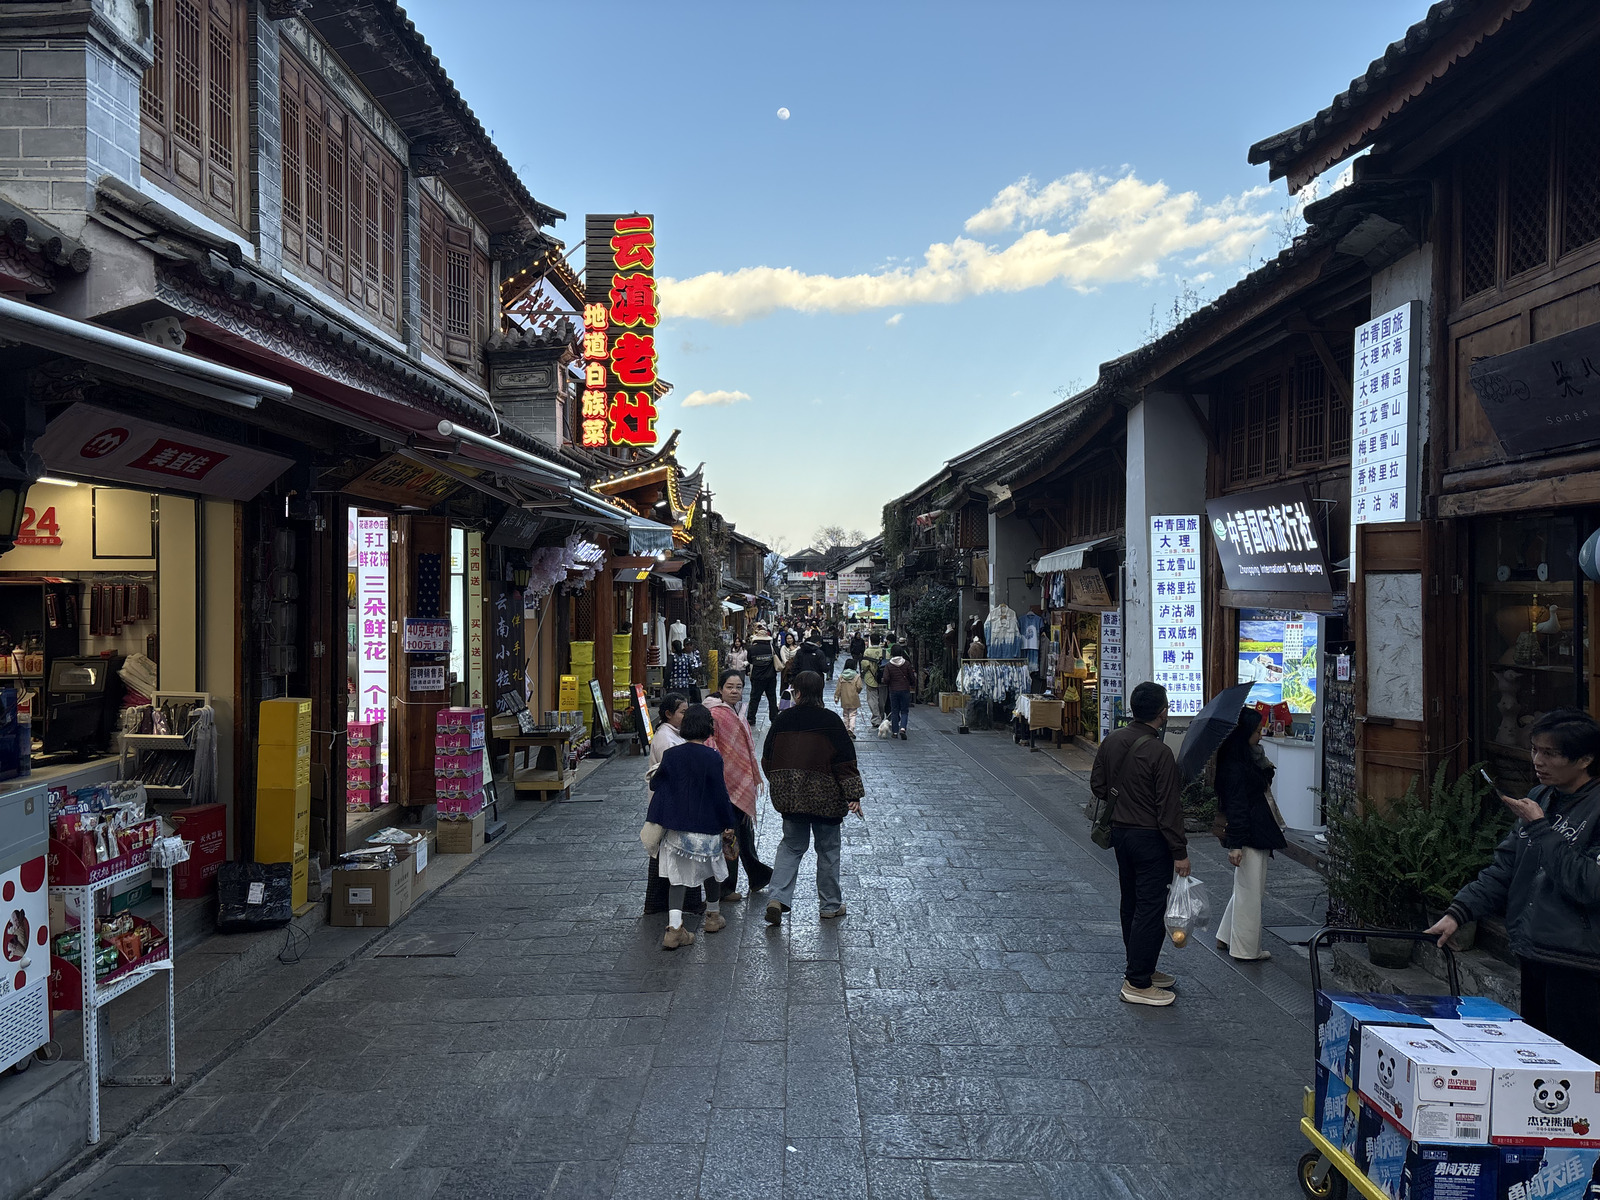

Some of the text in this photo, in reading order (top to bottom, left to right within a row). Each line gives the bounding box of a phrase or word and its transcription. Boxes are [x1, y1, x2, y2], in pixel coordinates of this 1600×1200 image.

[610, 216, 660, 447] 云滇老灶
[1360, 312, 1403, 348] 中青国旅
[1360, 337, 1402, 370] 大理环海
[582, 302, 609, 447] 地道白族菜
[1360, 368, 1402, 398] 大理精品
[1359, 399, 1400, 427] 玉龙雪山
[1546, 410, 1589, 424] Songs
[1359, 430, 1400, 457] 梅里雪山
[148, 447, 212, 474] 美宜佳
[1358, 461, 1398, 485] 香格里拉
[1357, 492, 1398, 514] 泸沽湖
[18, 506, 59, 536] 24
[1154, 518, 1197, 532] 中青国旅
[1226, 502, 1318, 555] 中青国际旅行社
[365, 533, 384, 548] 手工
[1160, 535, 1190, 548] 大理
[359, 551, 388, 567] 鲜花饼
[1157, 558, 1196, 571] 玉龙雪山
[1239, 562, 1323, 576] Zhongqing International Travel Agency
[1157, 581, 1196, 595] 香格里拉
[1103, 614, 1120, 626] 旅游
[1159, 604, 1194, 618] 泸沽湖
[470, 548, 482, 708] 买四送一，买六送二，全
[1158, 626, 1197, 640] 西双版纳
[364, 576, 386, 722] 三朵鲜花一个饼
[512, 614, 523, 682] 伴手礼
[1163, 650, 1194, 664] 腾冲
[411, 669, 443, 679] 招聘销售员
[200, 830, 223, 843] 灭火器箱
[1318, 1014, 1348, 1048] 勇闯天涯
[1374, 1082, 1395, 1106] 杰克熊猫
[1528, 1116, 1574, 1127] 杰克熊猫
[1366, 1134, 1402, 1162] 勇闯天涯
[1434, 1162, 1482, 1176] 勇闯天涯
[1508, 1154, 1586, 1200] 勇闯天涯
